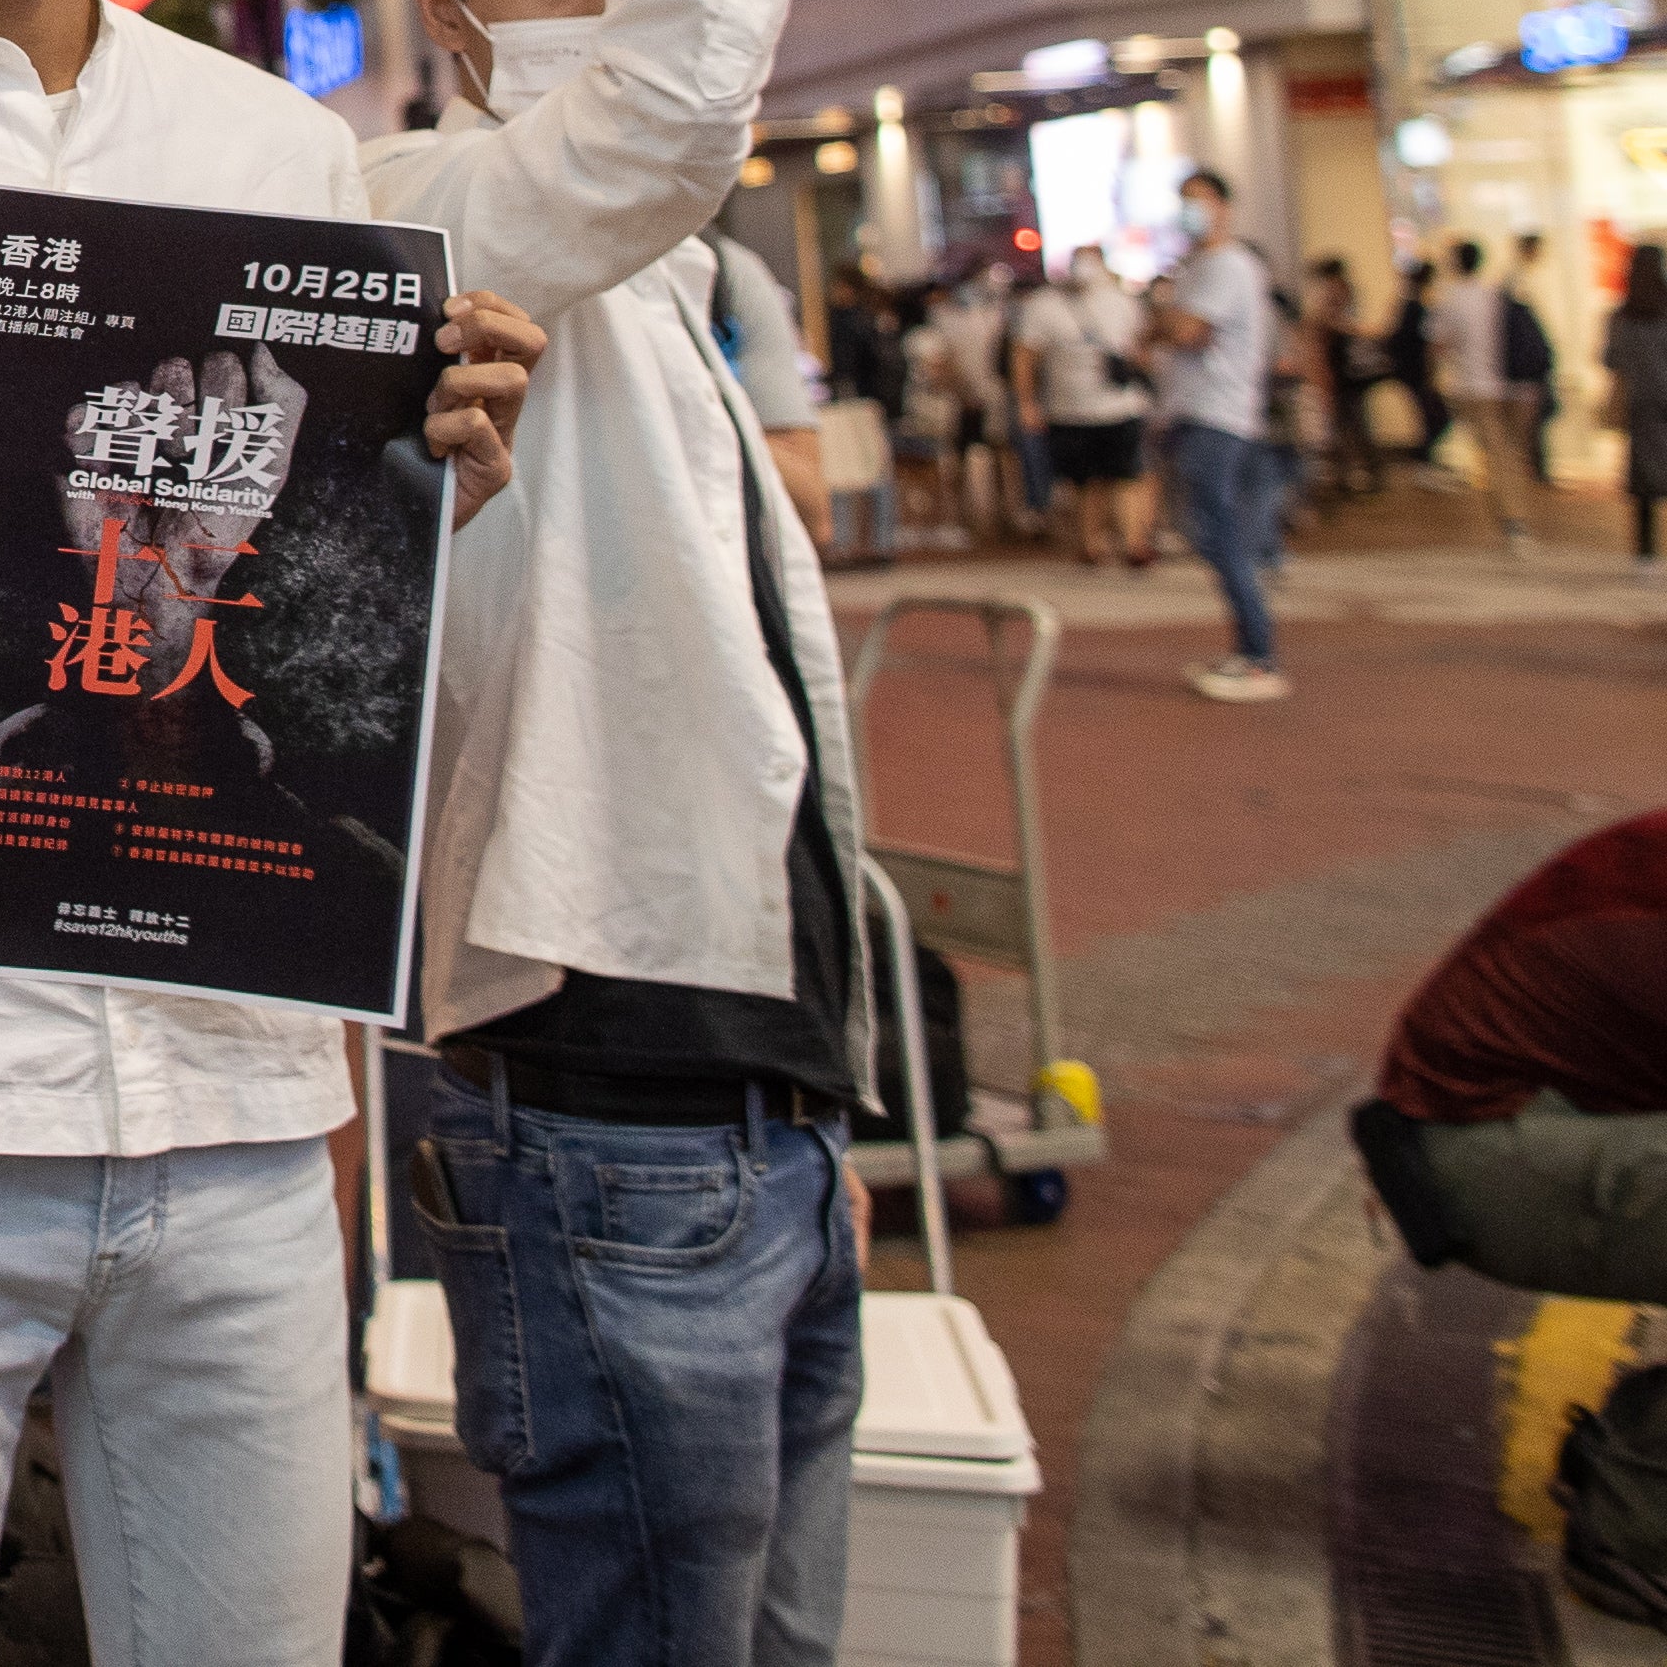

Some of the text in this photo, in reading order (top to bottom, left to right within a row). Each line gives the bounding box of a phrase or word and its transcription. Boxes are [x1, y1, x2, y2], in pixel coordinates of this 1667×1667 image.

[0, 234, 82, 273] 香港
[243, 261, 422, 308] 10月25日
[214, 303, 419, 356] 國際運動
[75, 386, 285, 488] 聲援
[67, 489, 96, 500] with
[154, 497, 189, 512] Hong
[191, 501, 224, 516] Kong
[228, 506, 273, 519] Youths
[68, 469, 151, 494] Global
[154, 478, 277, 510] Solidarity
[58, 518, 264, 608] 十二
[44, 602, 256, 709] 港人
